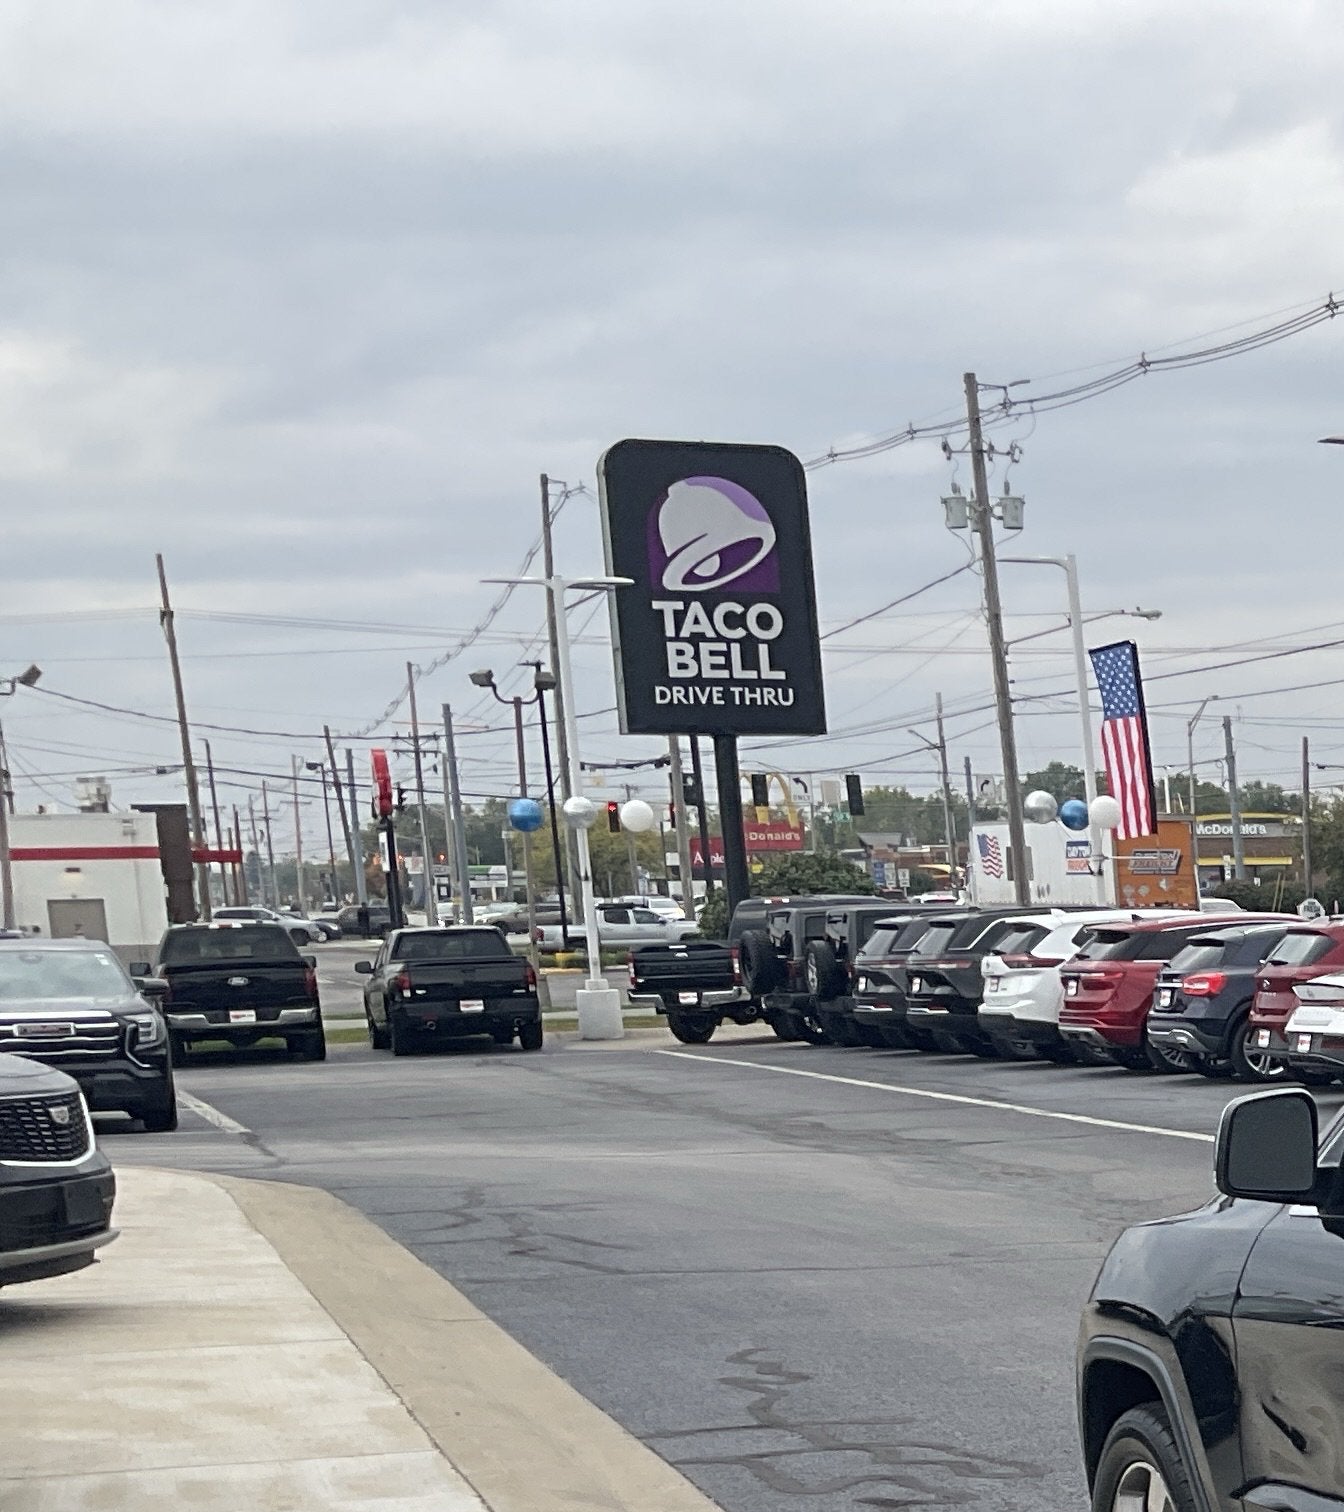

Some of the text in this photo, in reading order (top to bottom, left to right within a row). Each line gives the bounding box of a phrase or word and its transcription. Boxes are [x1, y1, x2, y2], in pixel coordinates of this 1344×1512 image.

[652, 600, 783, 640] TACO
[666, 641, 787, 680] BELL
[654, 685, 794, 706] DRIVE THRU
